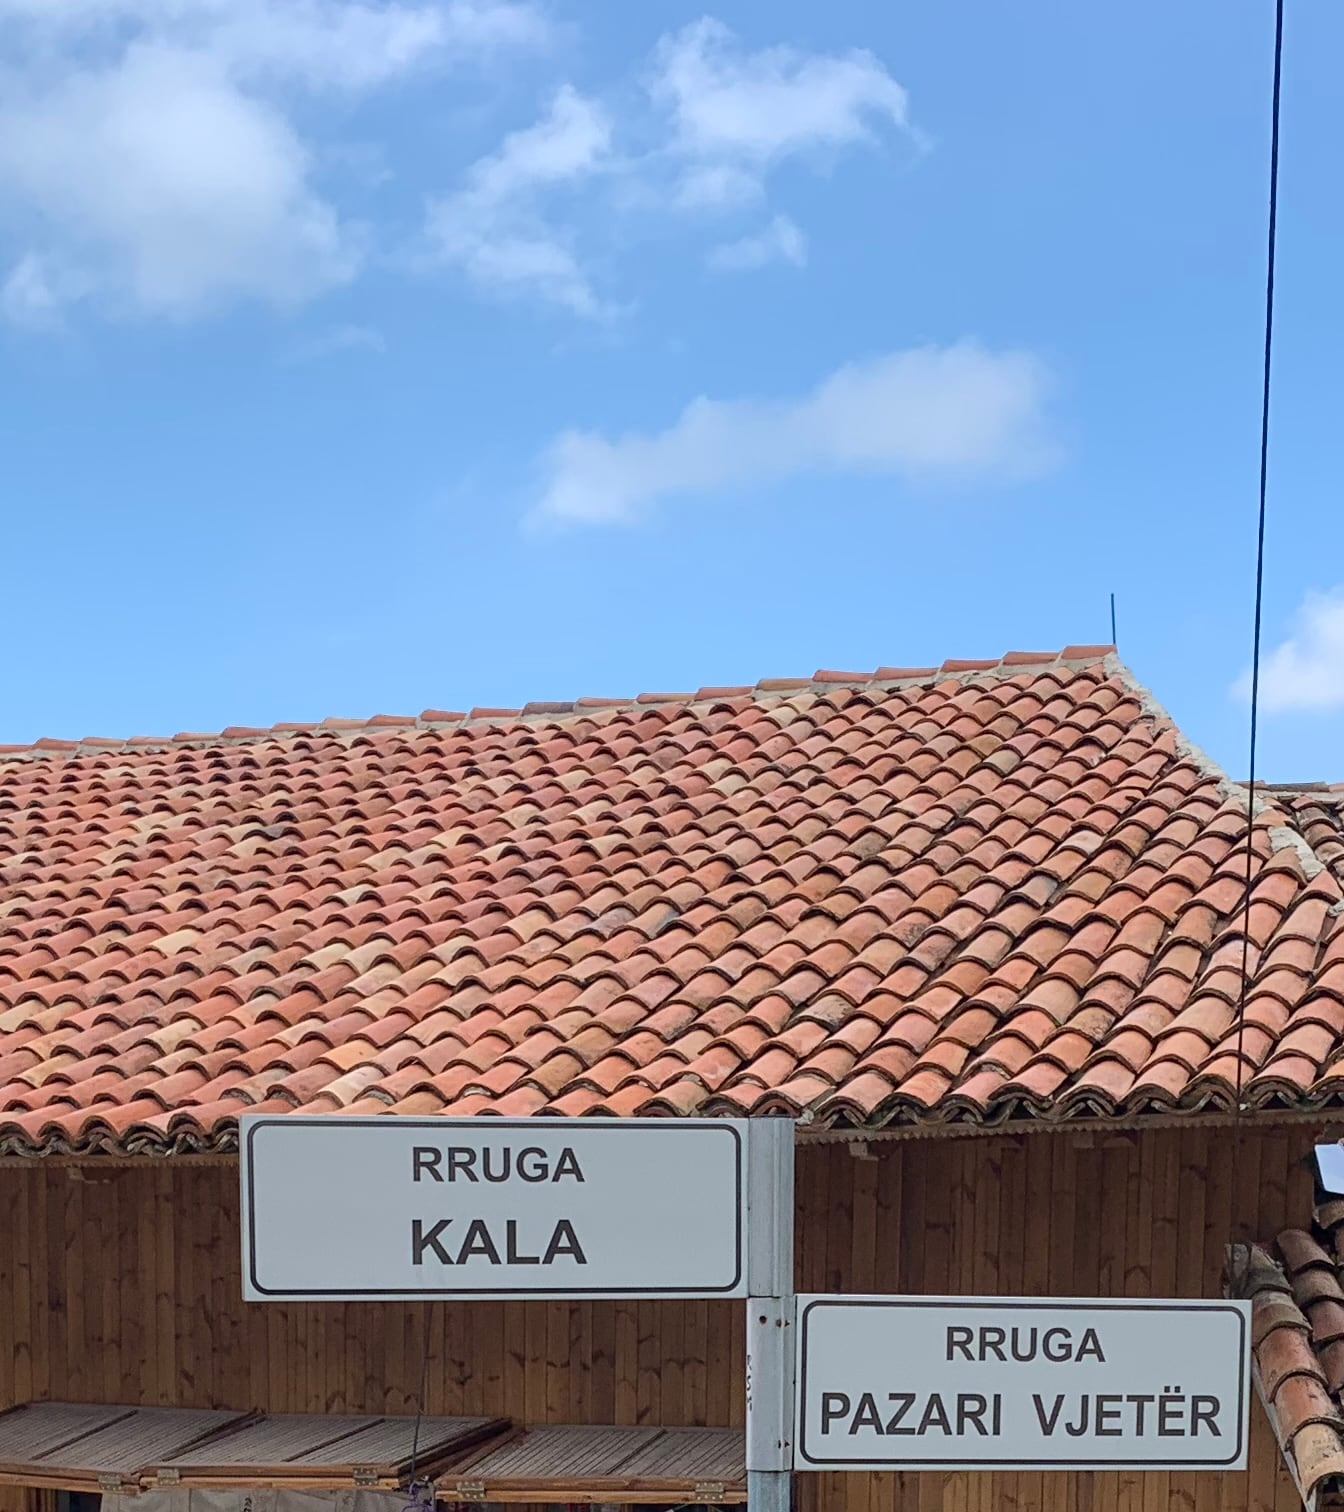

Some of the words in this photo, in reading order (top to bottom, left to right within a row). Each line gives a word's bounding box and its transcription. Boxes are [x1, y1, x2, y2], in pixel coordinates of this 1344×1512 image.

[412, 1146, 586, 1183] RRUGA
[411, 1218, 588, 1266] KALA
[946, 1326, 1106, 1363] RRUGA
[820, 1391, 1003, 1436] PAZARI
[1031, 1385, 1222, 1437] VJETËR
